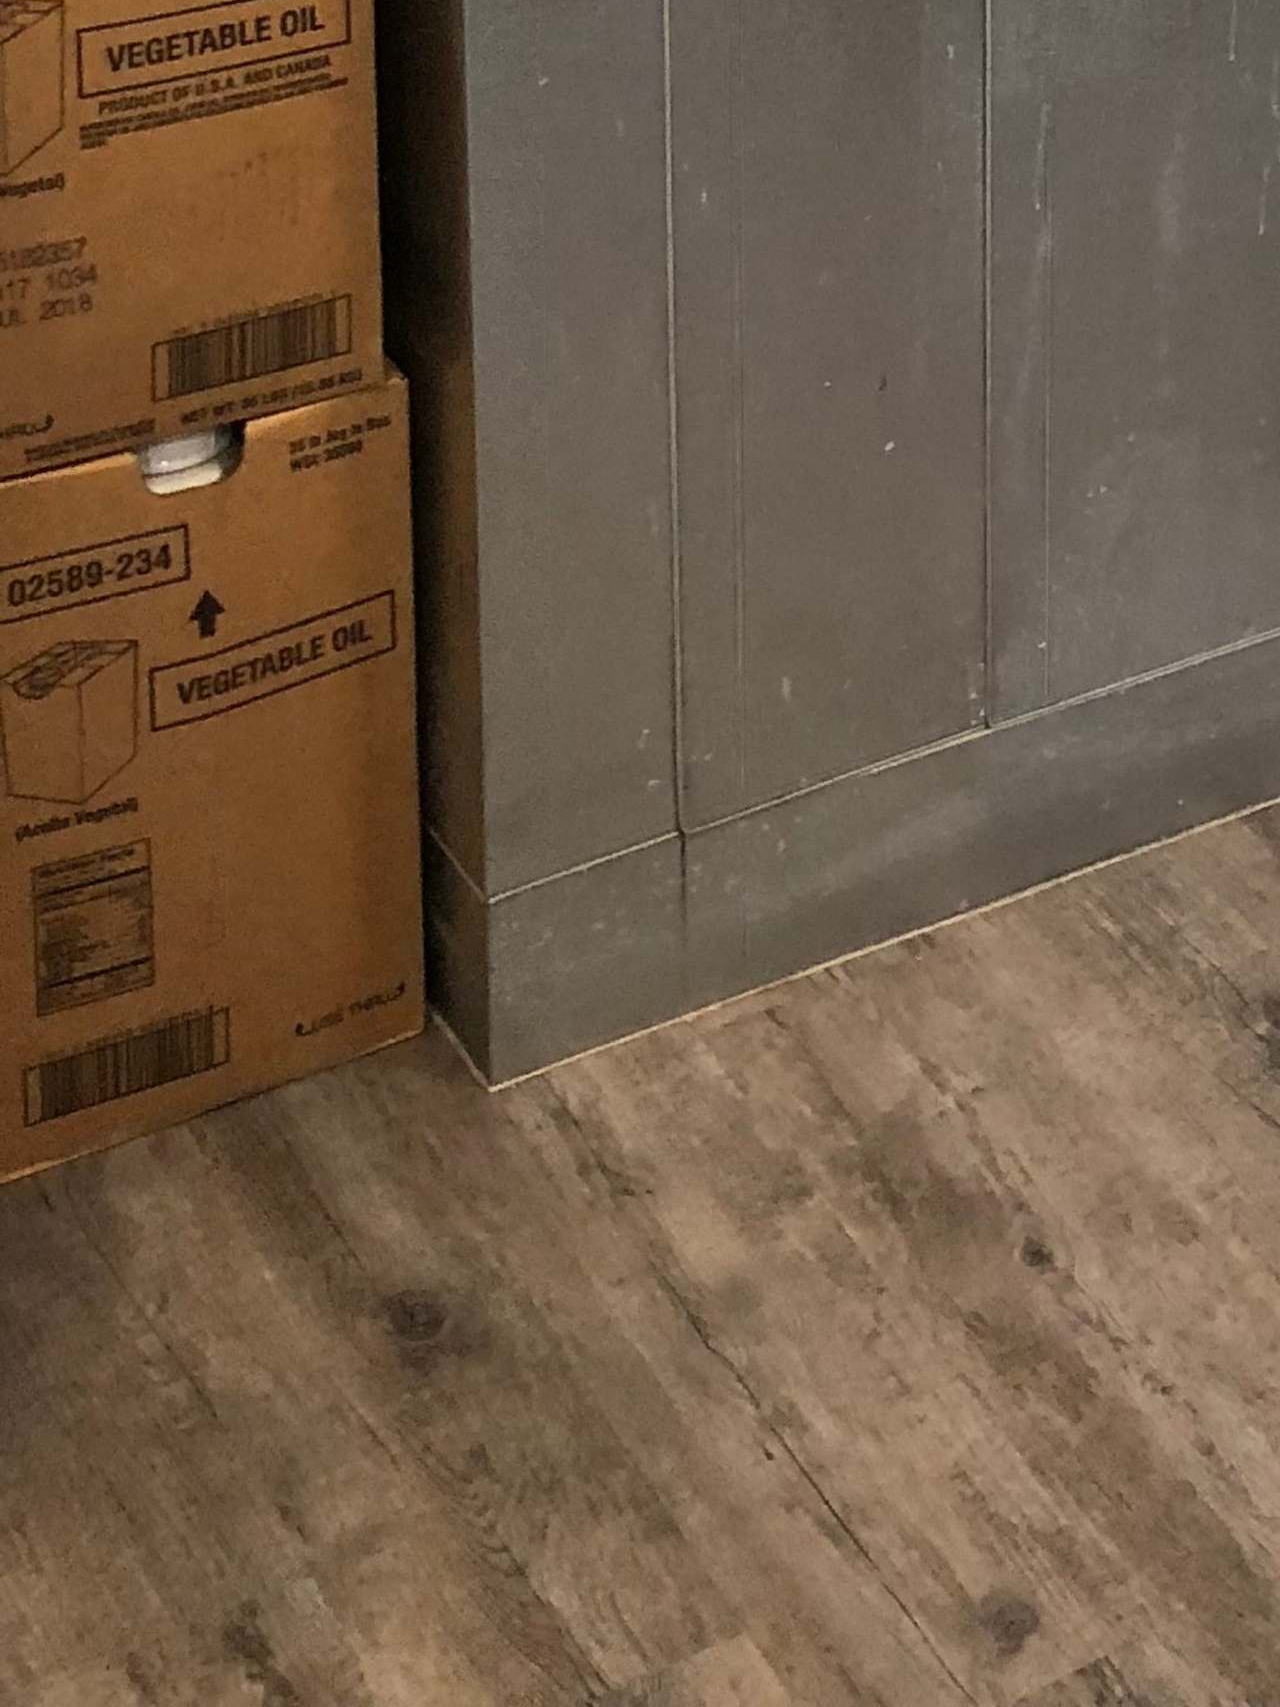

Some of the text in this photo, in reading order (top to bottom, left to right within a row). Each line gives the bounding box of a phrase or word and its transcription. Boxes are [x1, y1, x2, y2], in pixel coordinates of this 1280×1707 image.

[106, 4, 325, 73] VEGETABLE OIL
[7, 544, 172, 607] 02589-234
[177, 618, 373, 706] VEGETABLE OIL
